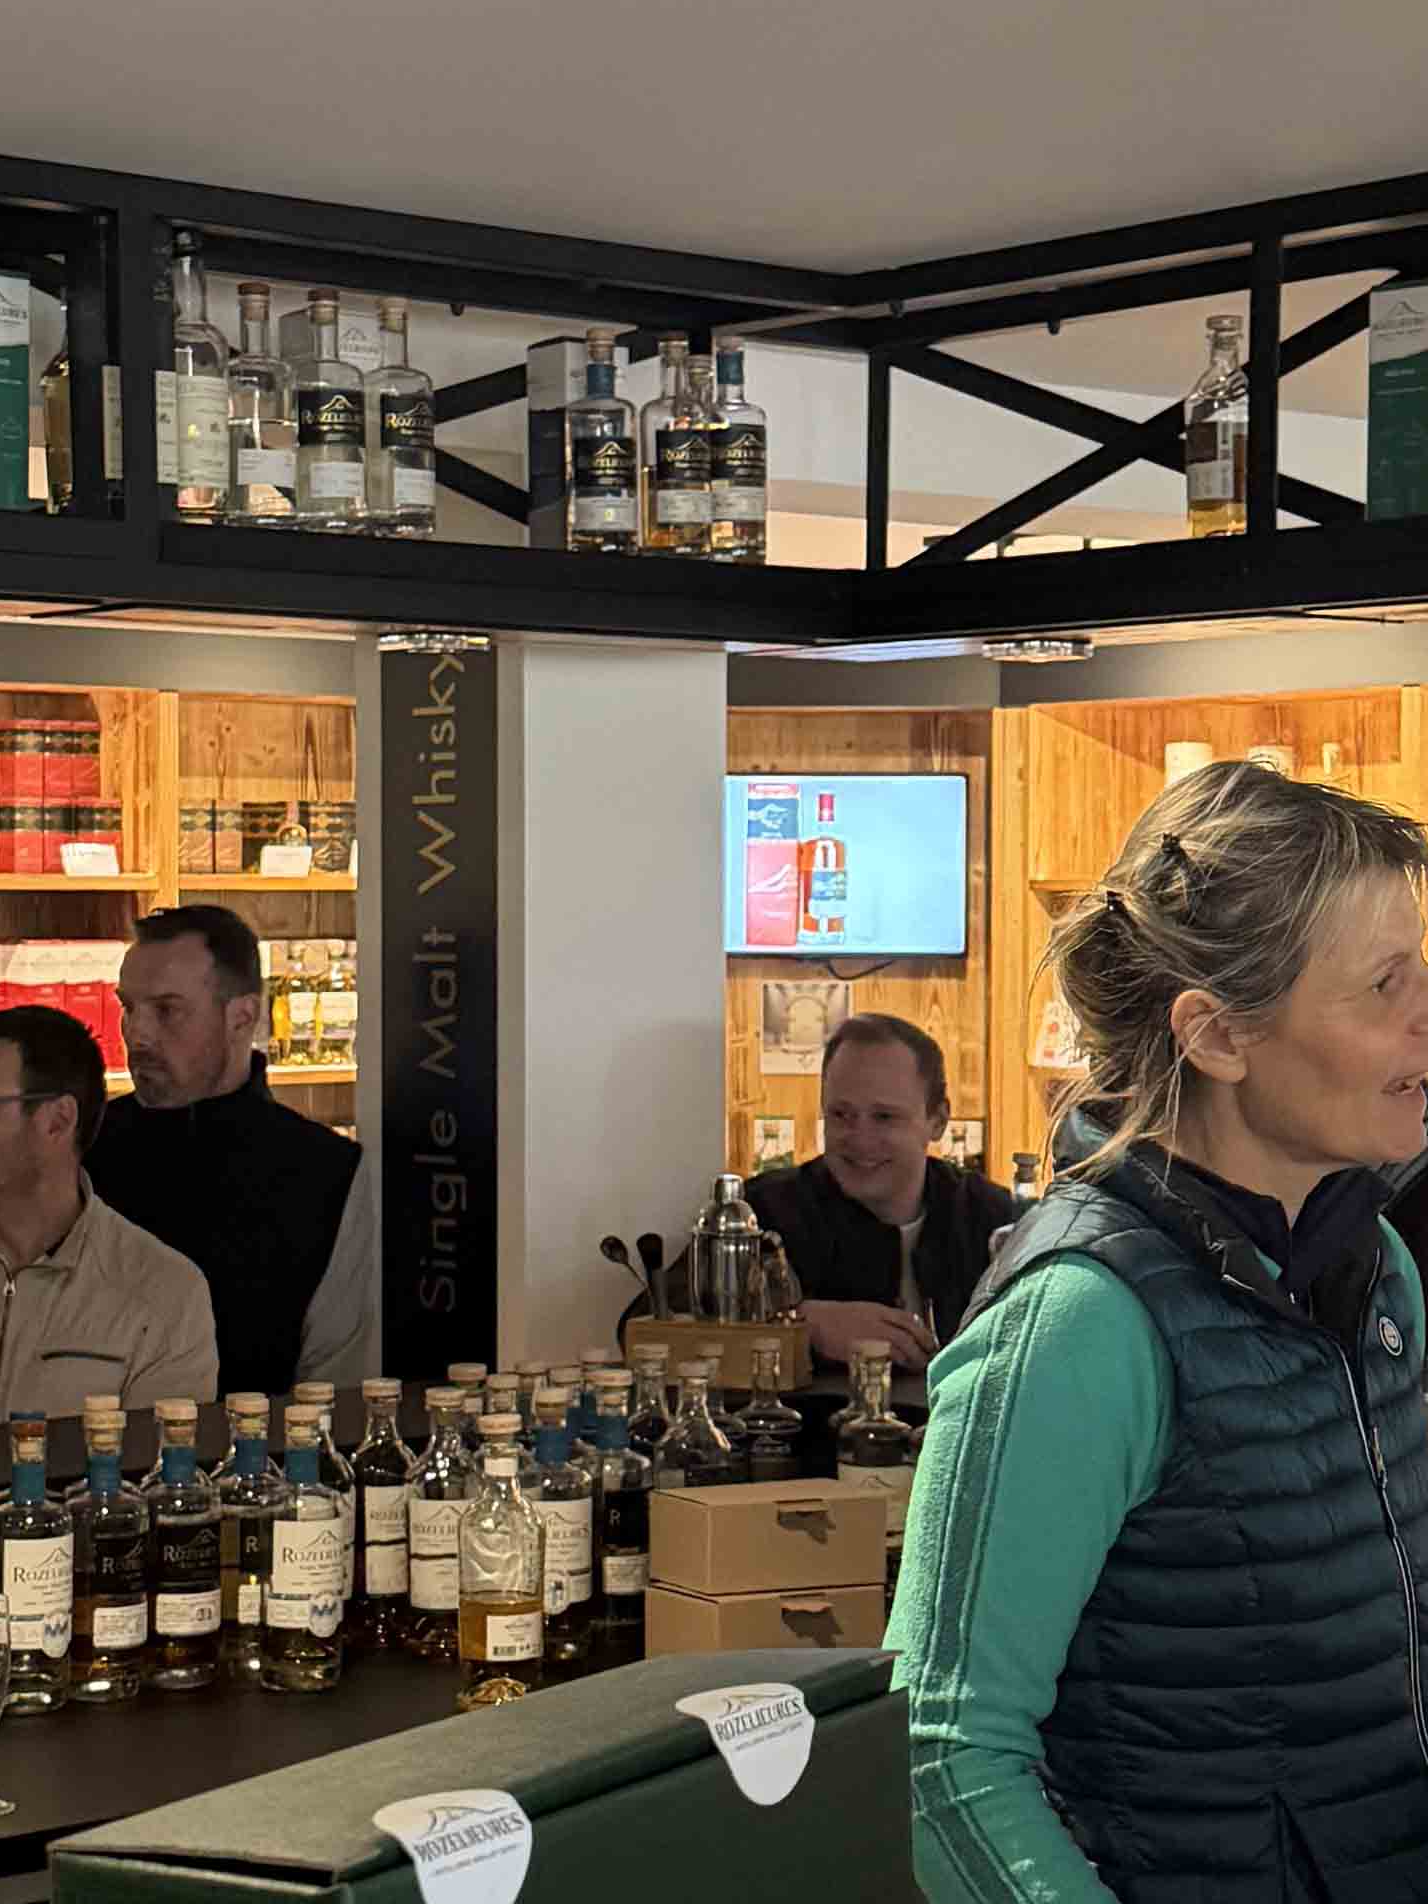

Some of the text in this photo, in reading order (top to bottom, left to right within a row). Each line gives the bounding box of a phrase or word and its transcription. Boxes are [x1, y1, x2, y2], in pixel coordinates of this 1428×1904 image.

[410, 653, 467, 1313] Single Malt Whisky
